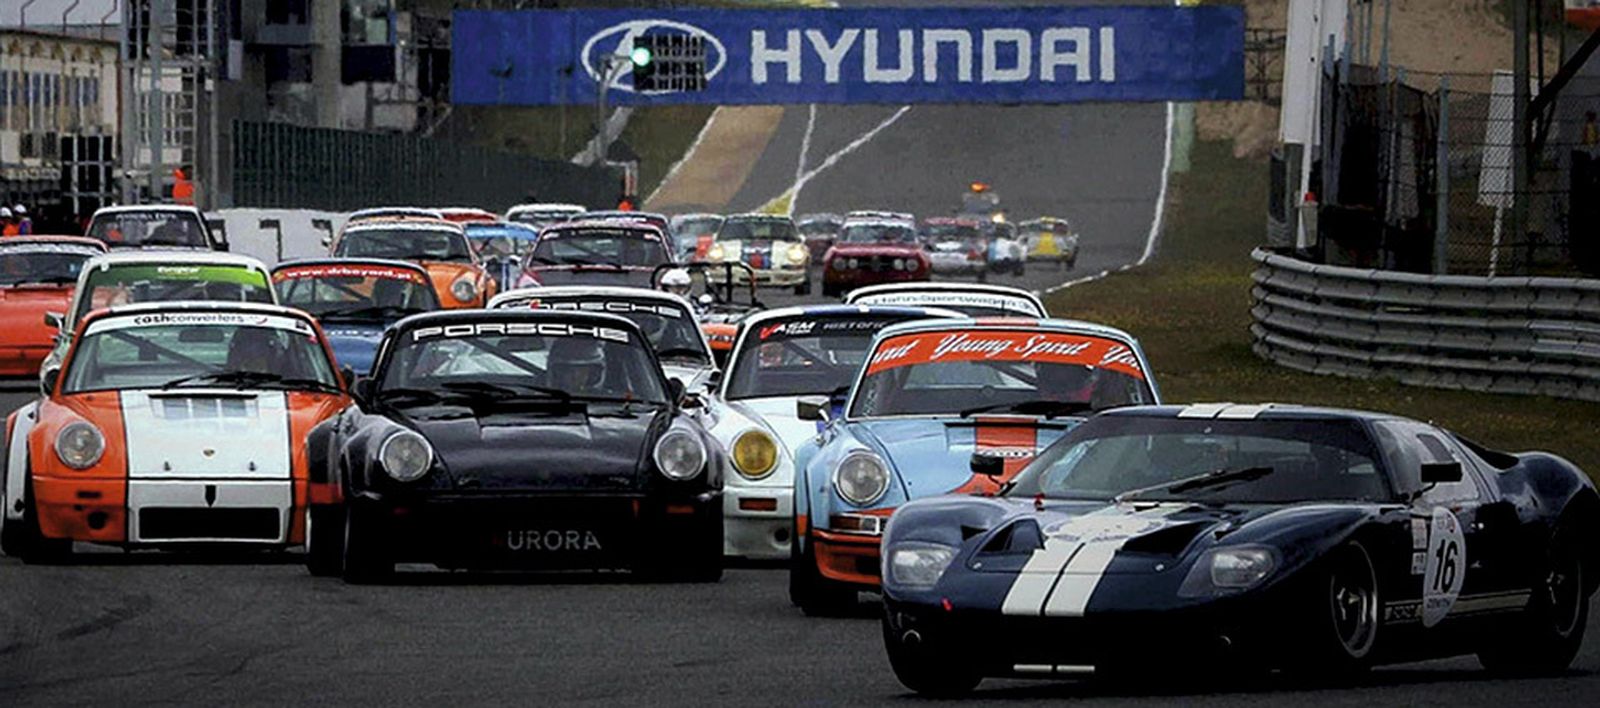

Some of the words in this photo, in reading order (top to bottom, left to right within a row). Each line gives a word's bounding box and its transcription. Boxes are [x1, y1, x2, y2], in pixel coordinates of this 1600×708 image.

[751, 27, 1115, 84] HYUNDAI
[413, 323, 629, 342] PORSCHE
[931, 333, 1013, 361] Young
[1014, 335, 1092, 359] Spirit
[493, 530, 601, 551] URORA
[1433, 539, 1458, 593] 16
